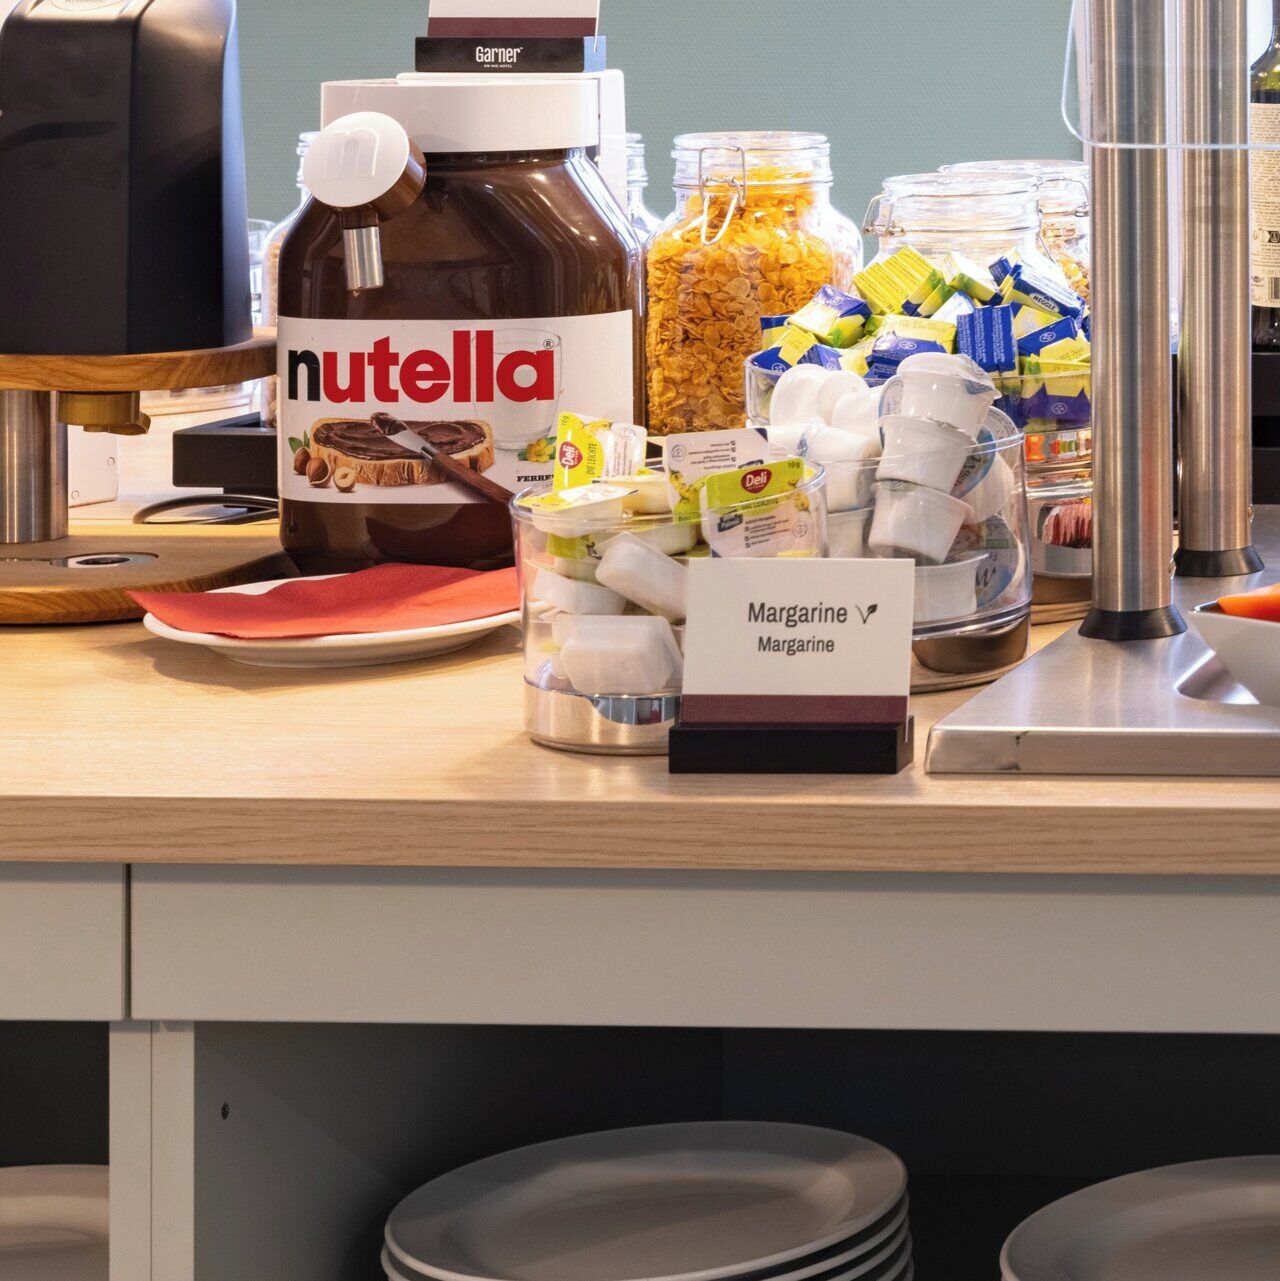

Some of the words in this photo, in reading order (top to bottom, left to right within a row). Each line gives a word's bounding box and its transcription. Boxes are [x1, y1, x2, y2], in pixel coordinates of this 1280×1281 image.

[475, 46, 521, 64] Garner
[1033, 295, 1056, 311] MEGGLE
[287, 329, 555, 404] nutella
[562, 445, 576, 466] Deli
[745, 471, 767, 487] Deli
[748, 602, 848, 628] Margarine
[758, 636, 835, 656] Margarine
